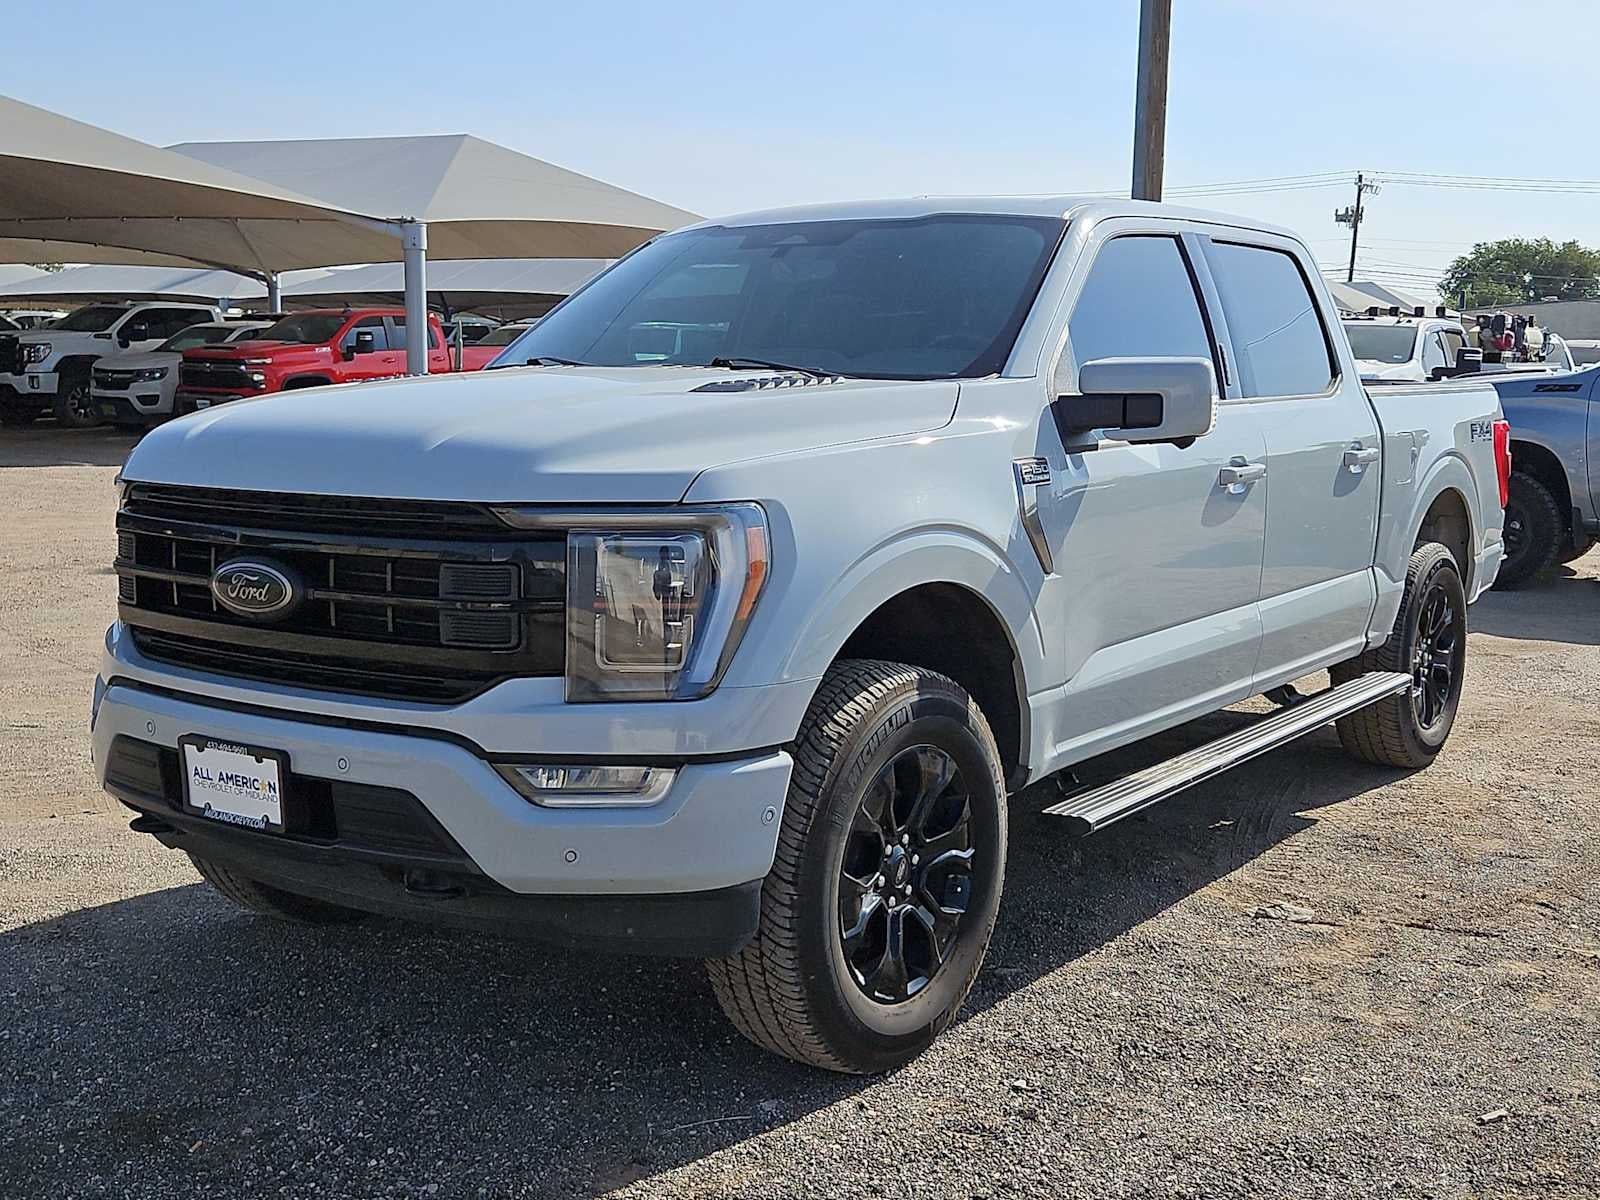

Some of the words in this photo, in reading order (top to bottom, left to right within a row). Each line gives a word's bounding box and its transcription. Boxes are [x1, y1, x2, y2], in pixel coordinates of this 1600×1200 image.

[227, 572, 270, 602] Ford
[193, 766, 213, 781] ALL
[218, 771, 278, 795] AMERICN
[193, 779, 233, 795] CHEVROLET
[234, 787, 244, 797] OF
[245, 790, 279, 804] MIDLAND
